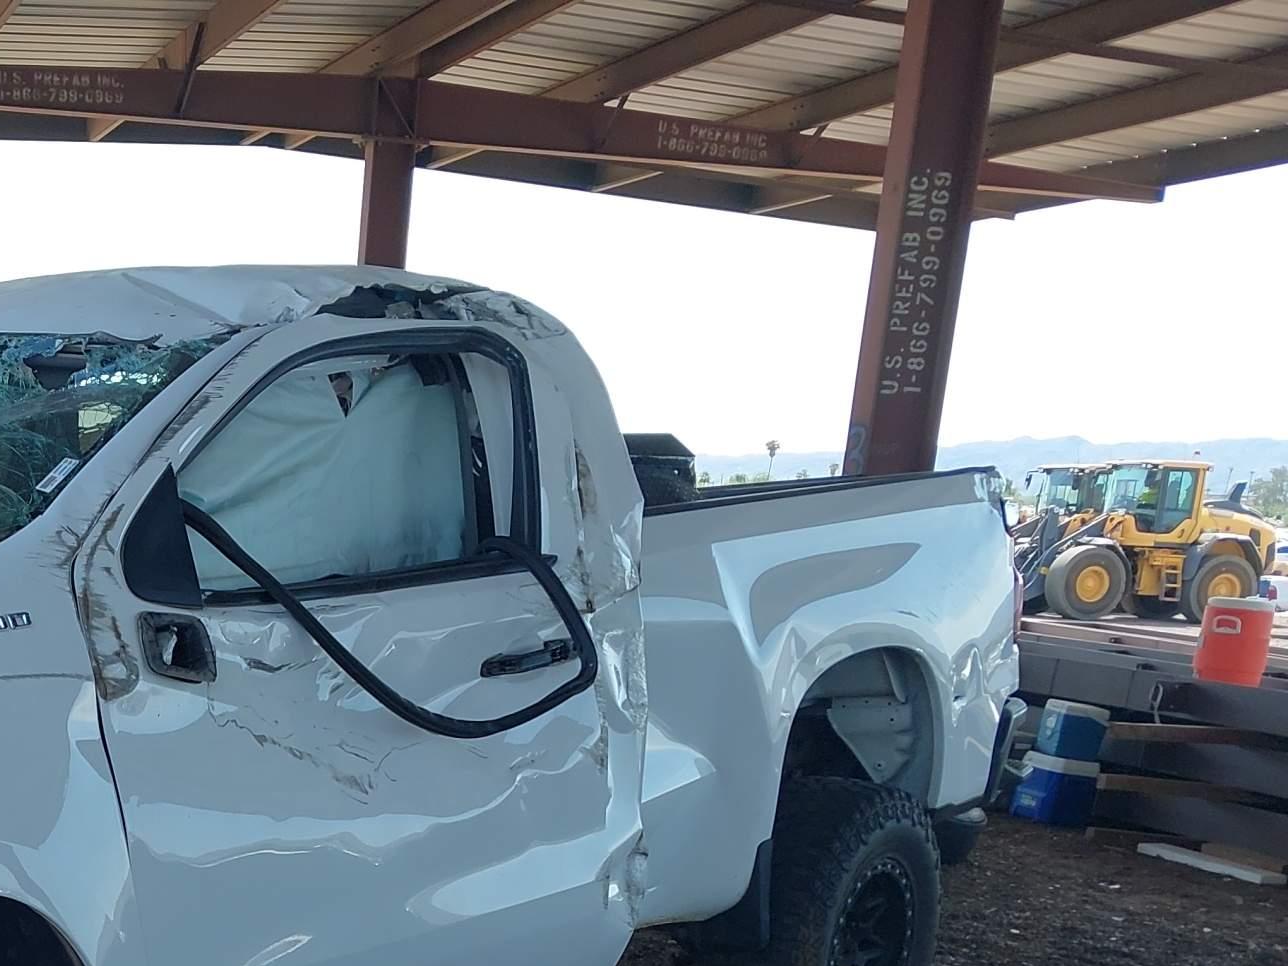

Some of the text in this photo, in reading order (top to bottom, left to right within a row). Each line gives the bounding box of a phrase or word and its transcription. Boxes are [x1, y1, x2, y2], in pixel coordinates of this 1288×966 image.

[880, 168, 929, 394] U.S. PREFAB INC.
[903, 172, 952, 392] 1-866-799-0969
